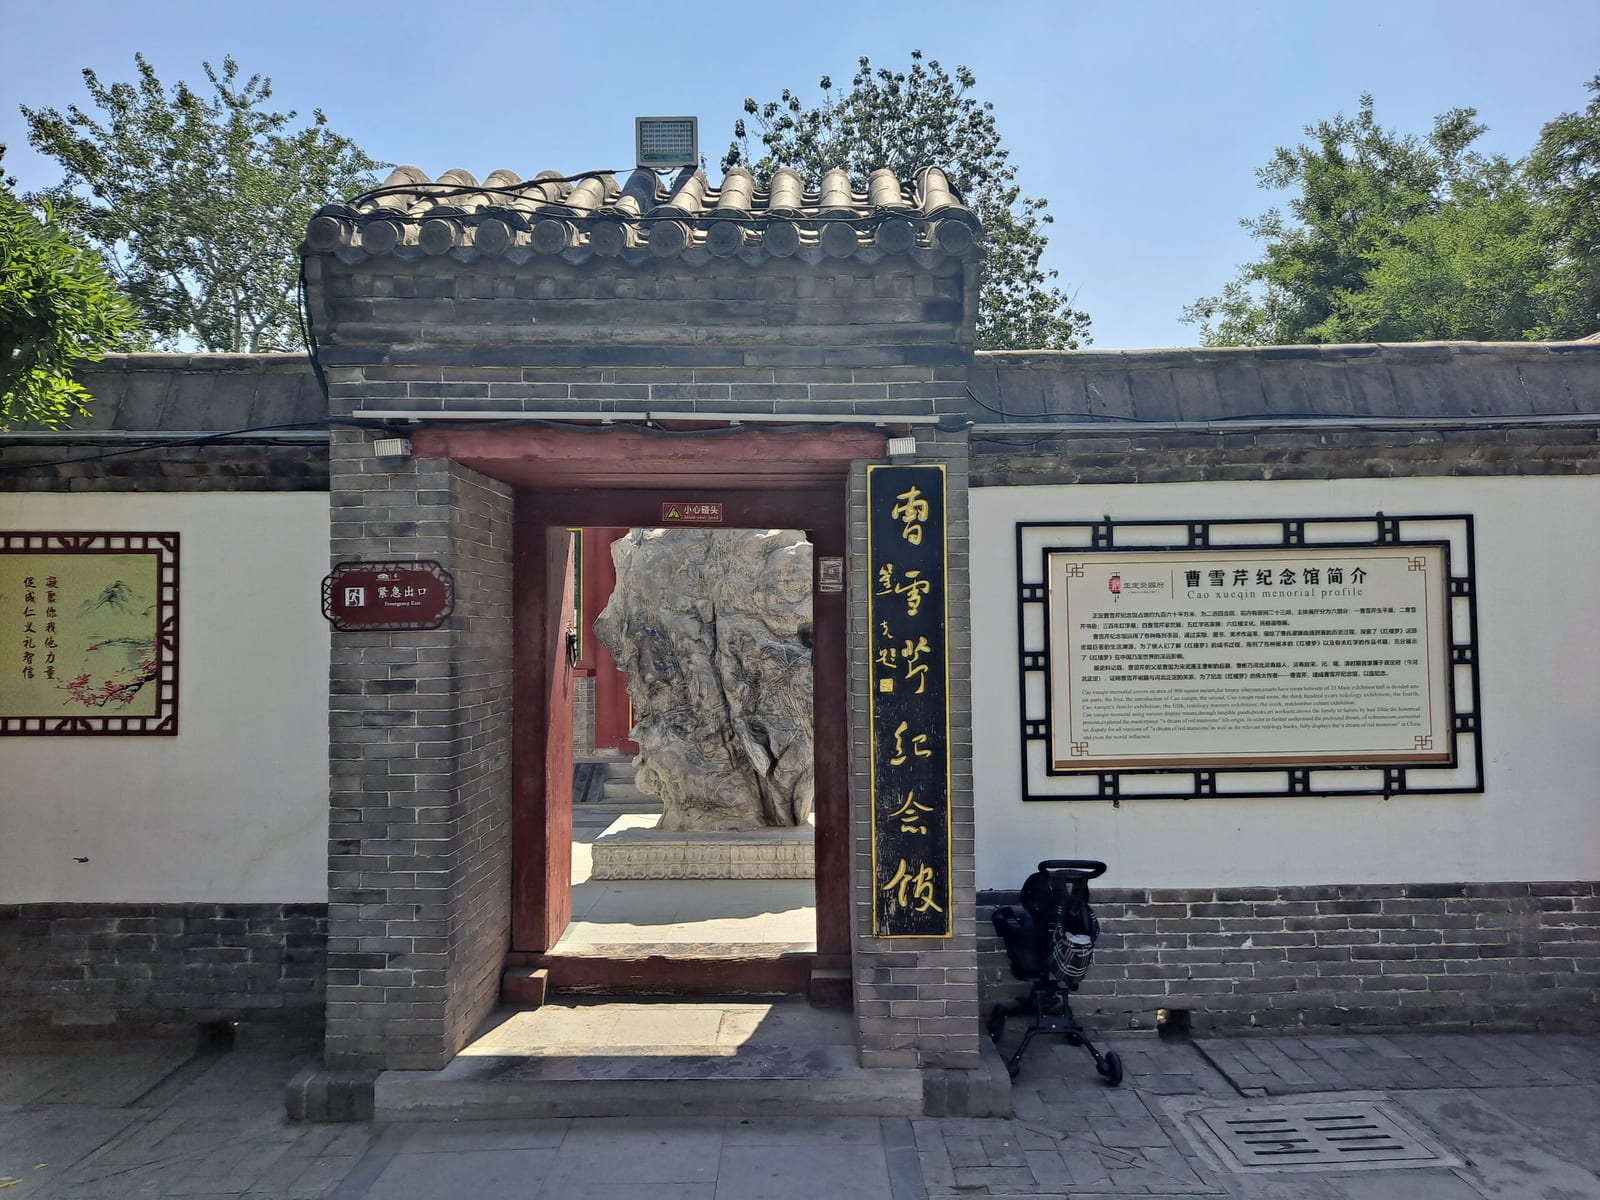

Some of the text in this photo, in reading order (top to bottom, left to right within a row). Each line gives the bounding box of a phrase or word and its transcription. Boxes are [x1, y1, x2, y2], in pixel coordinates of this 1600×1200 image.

[684, 505, 718, 514] 小心碰头
[1184, 567, 1367, 587] 曹雪芹纪念馆简介
[377, 586, 427, 598] 紧急出口
[1187, 590, 1209, 599] Cao
[1216, 589, 1256, 600] xueqin
[1321, 587, 1363, 599] profile
